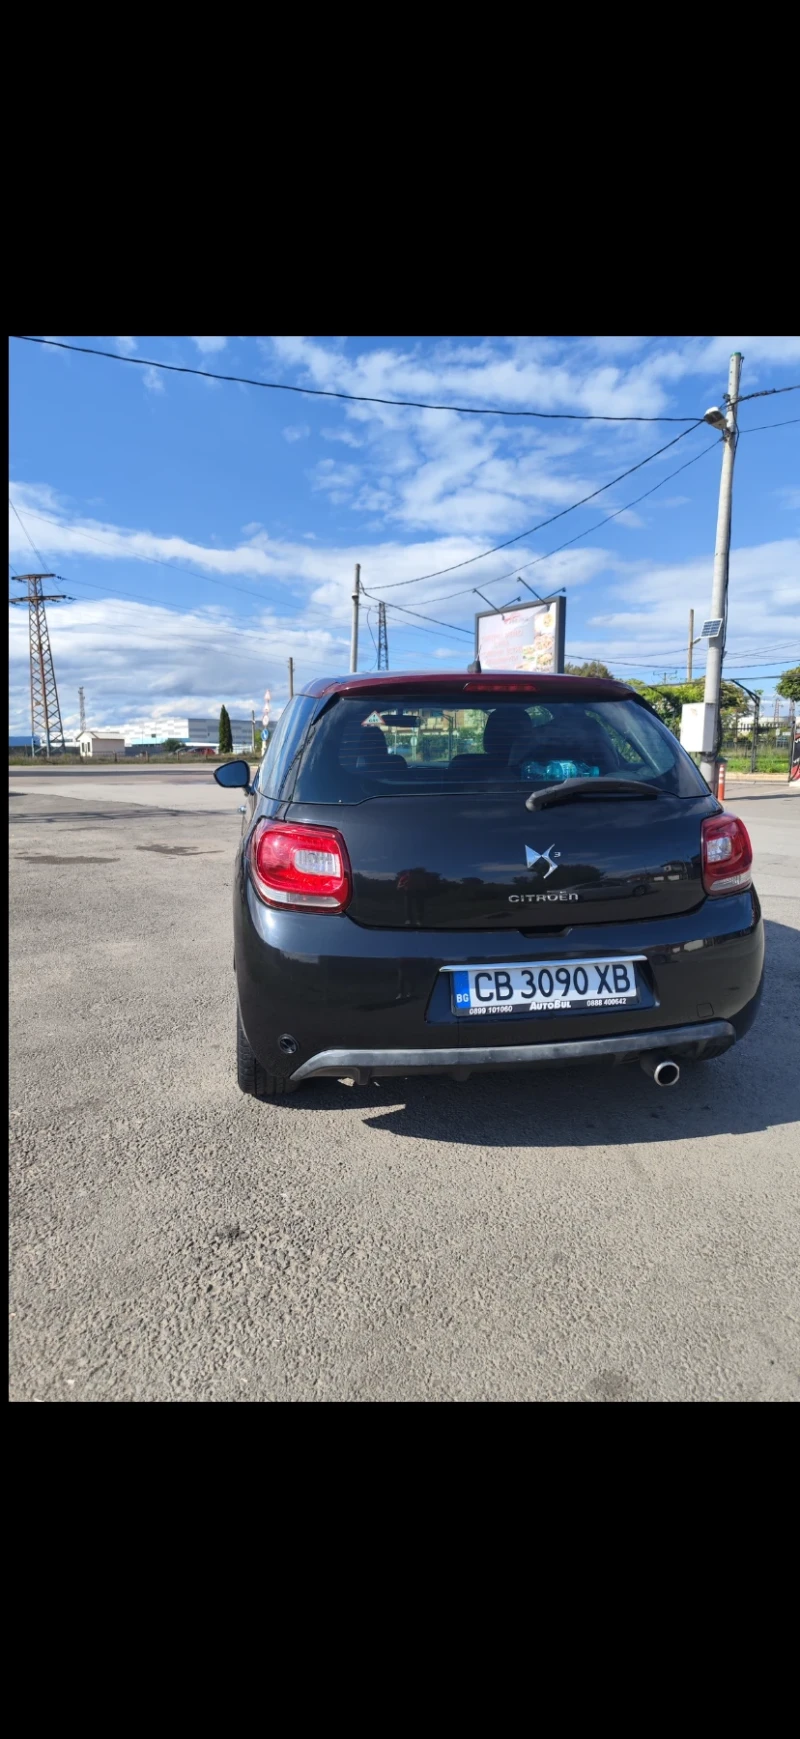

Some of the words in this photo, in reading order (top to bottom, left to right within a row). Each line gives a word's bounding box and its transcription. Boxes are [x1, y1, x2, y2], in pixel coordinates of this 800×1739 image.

[474, 971, 514, 1002] CB
[521, 966, 589, 998] 3090
[594, 964, 631, 994] XB
[456, 993, 469, 1003] BG
